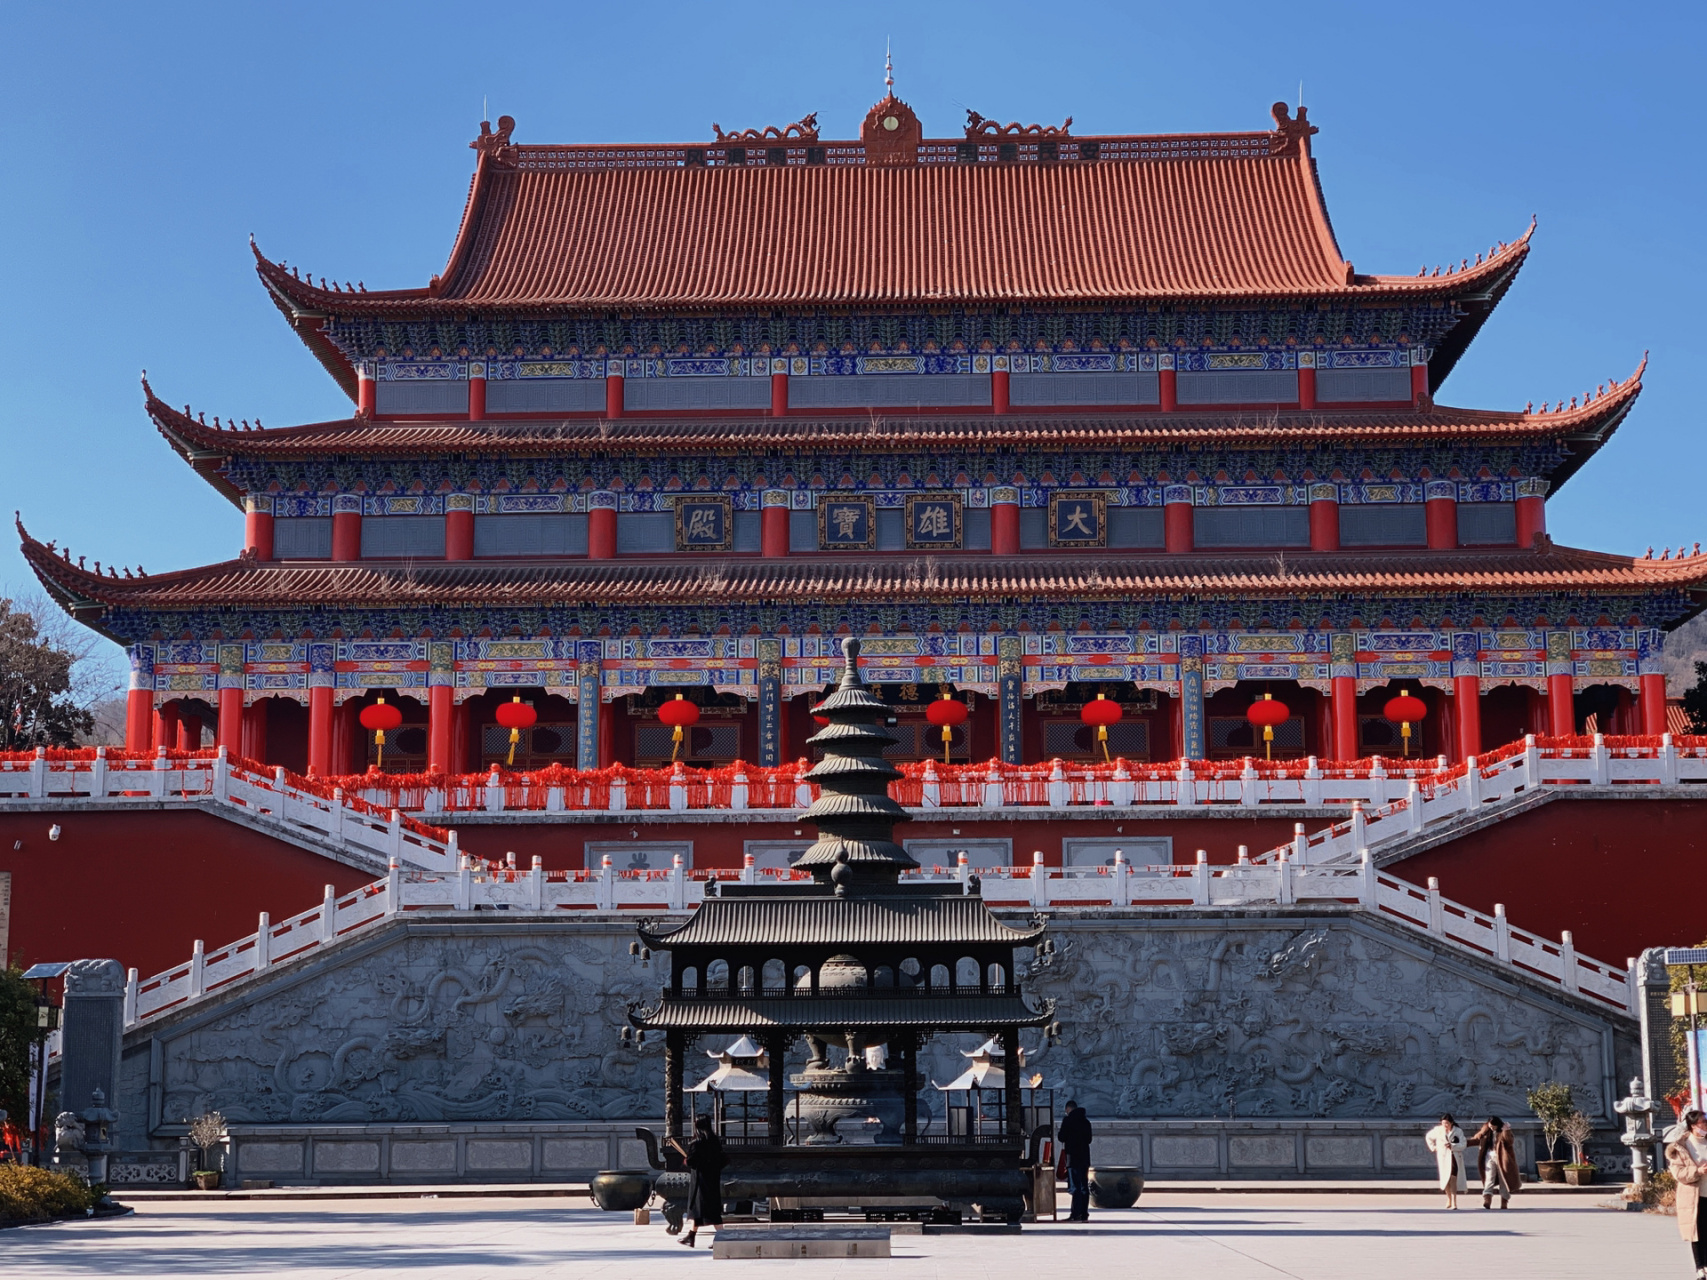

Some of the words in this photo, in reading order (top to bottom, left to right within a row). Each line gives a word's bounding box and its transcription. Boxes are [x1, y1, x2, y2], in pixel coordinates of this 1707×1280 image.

[687, 508, 719, 540] 殿
[832, 506, 862, 540] 寶
[917, 505, 951, 536] 雄
[1062, 505, 1093, 535] 大
